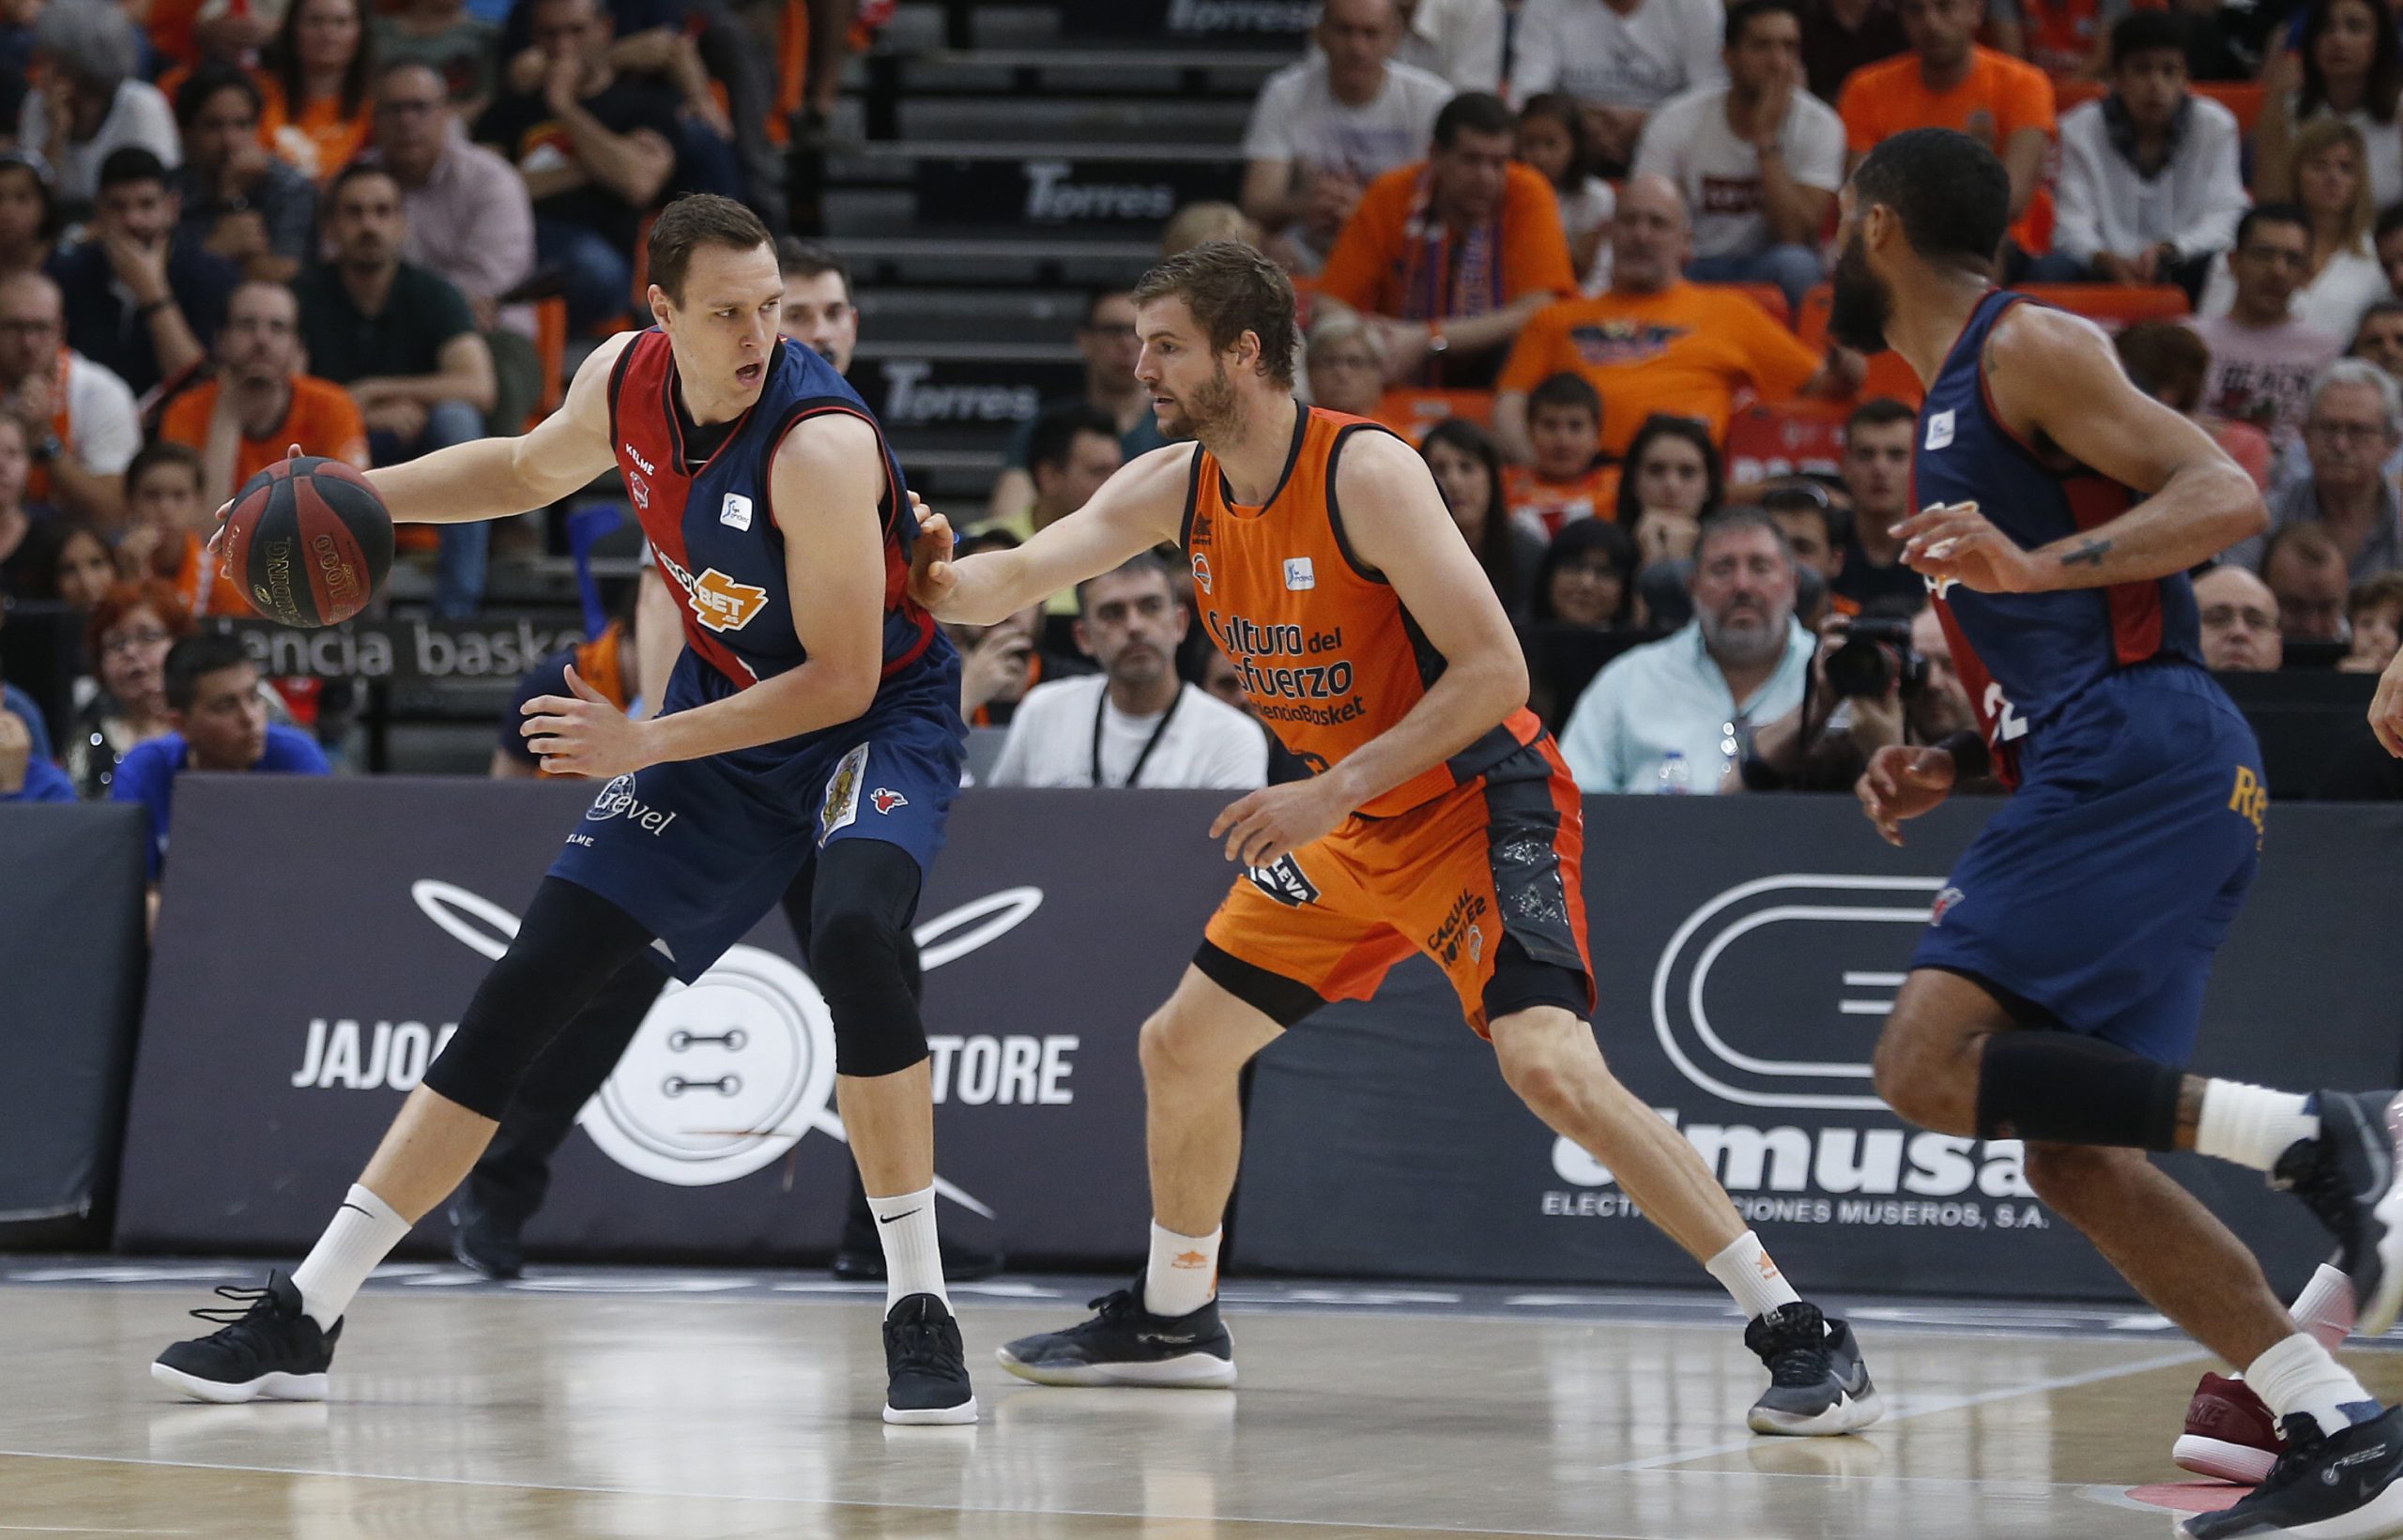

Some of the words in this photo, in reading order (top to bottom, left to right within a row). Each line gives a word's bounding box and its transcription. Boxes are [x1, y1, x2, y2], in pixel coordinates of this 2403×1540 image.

[1023, 161, 1174, 219] Torres
[881, 360, 1039, 420] Torres
[625, 443, 655, 477] KELME
[313, 534, 348, 599] 1000
[218, 617, 394, 677] encia
[414, 618, 588, 677] bask
[1308, 626, 1343, 654] del
[1232, 656, 1354, 700] sfuerzo
[594, 774, 678, 837] Gevel
[565, 832, 595, 848] ELME
[926, 1034, 1080, 1105] TORE
[1551, 1106, 2040, 1198] emusa
[1836, 1199, 1988, 1231] MUSEROS,
[1994, 1203, 2051, 1230] S.A.
